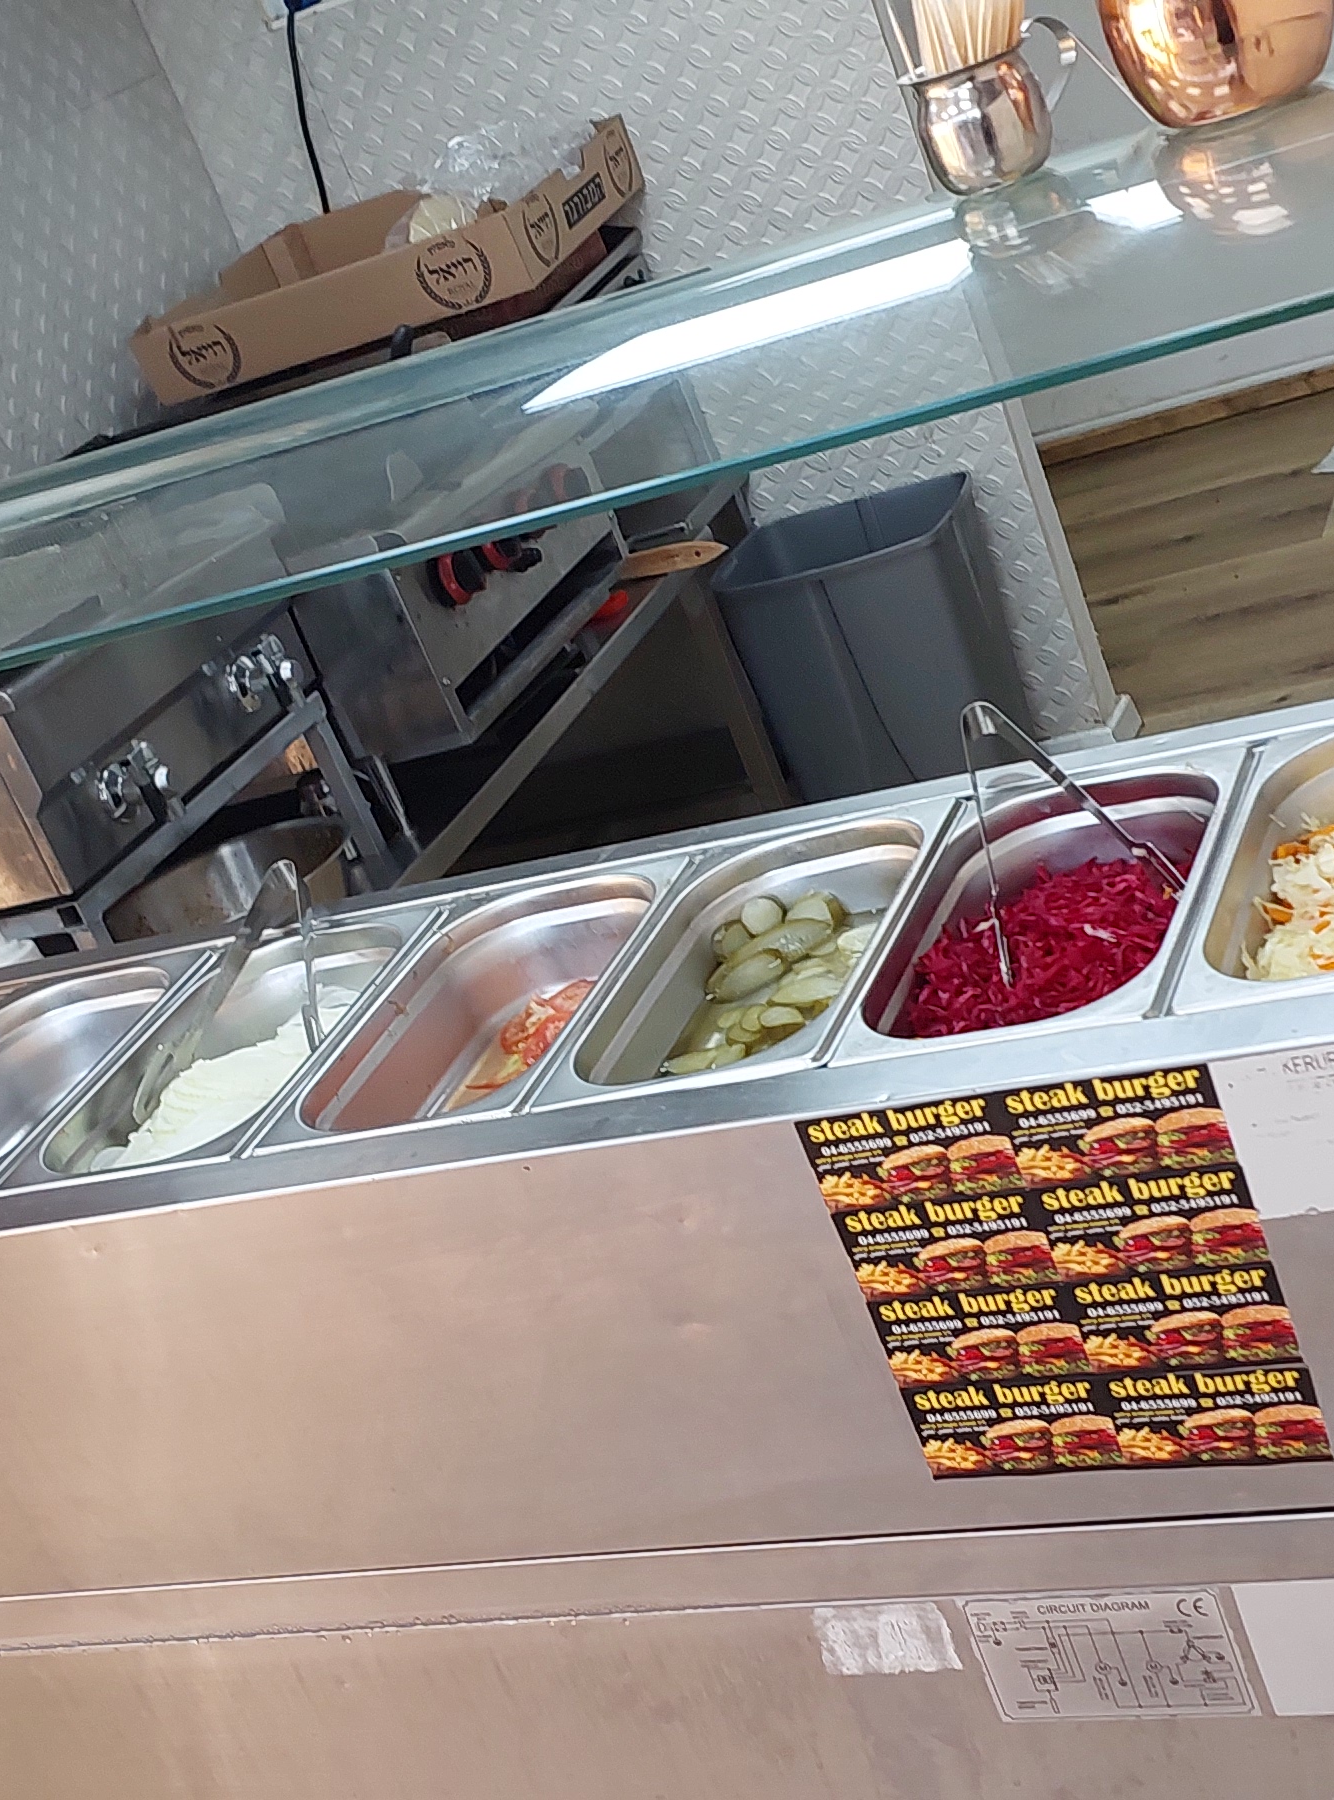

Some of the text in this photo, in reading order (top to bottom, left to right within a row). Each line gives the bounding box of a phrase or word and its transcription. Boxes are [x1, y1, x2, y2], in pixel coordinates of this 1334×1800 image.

[423, 256, 478, 285] רויאל
[175, 339, 227, 366] רויאל
[1005, 1068, 1201, 1114] steak burger
[807, 1097, 986, 1143] steak burger
[1041, 1170, 1236, 1211] steak burger
[844, 1195, 1024, 1233] steak burger
[1073, 1268, 1267, 1304] steak burger
[878, 1287, 1057, 1322] steak burger
[913, 1380, 1091, 1411] steak burger
[1108, 1369, 1301, 1398] steak burger
[1036, 1600, 1150, 1615] CIRCUIT DIAGRAM
